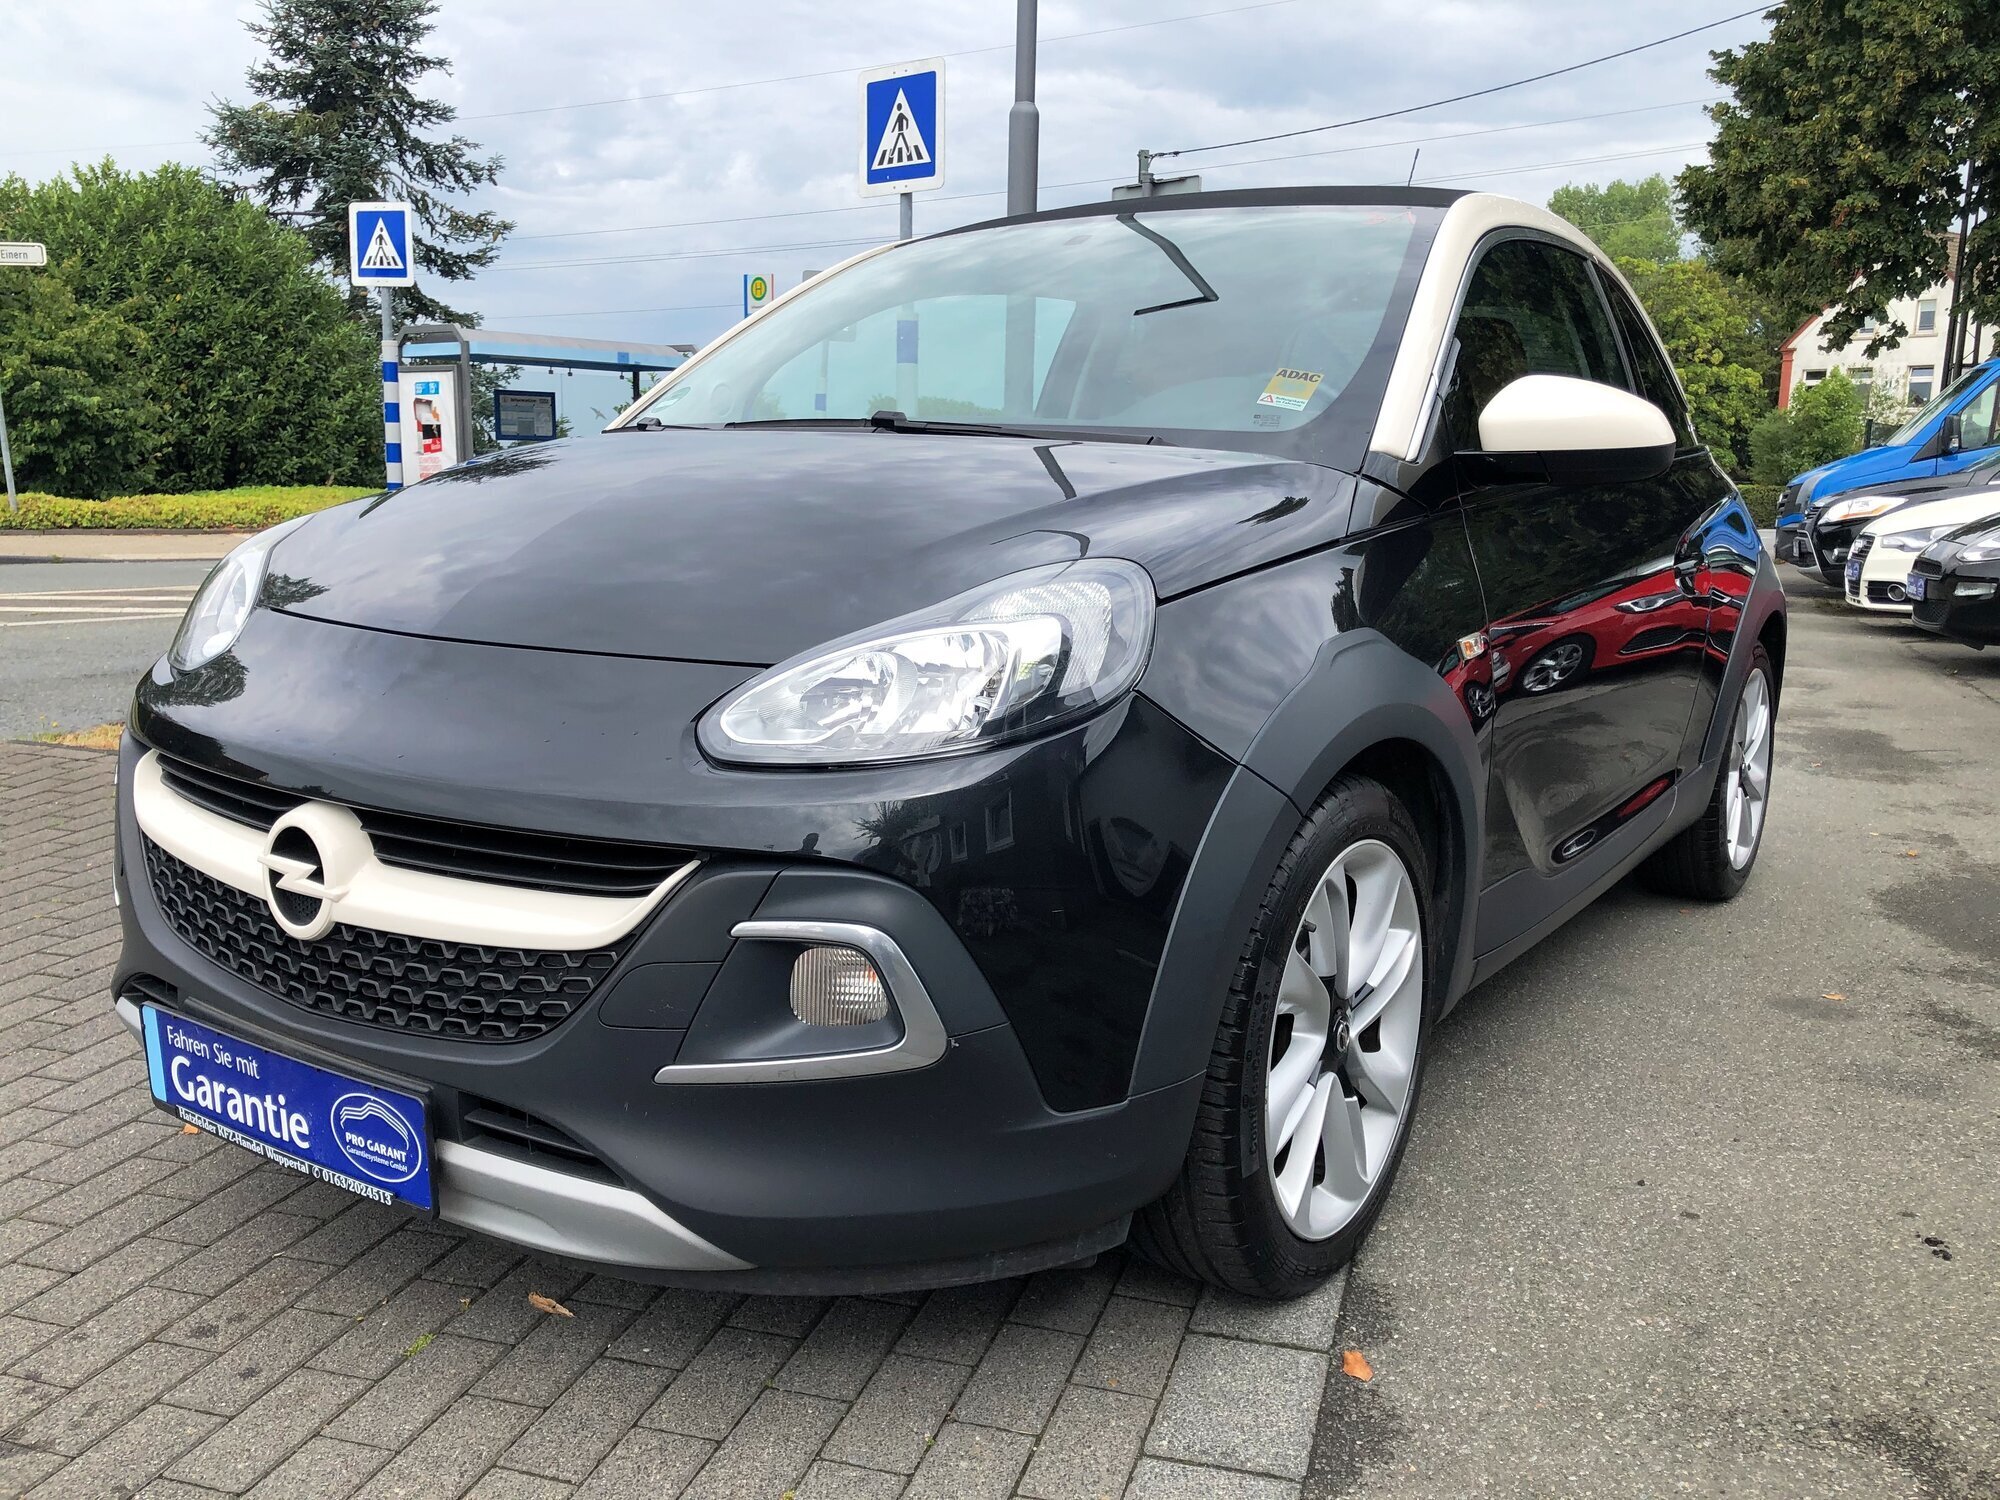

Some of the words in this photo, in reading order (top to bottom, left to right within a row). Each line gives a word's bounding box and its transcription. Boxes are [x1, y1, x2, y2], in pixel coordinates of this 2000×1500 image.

[1, 249, 28, 259] Einern
[1276, 369, 1321, 383] ADAC
[166, 1025, 210, 1060] Fahren
[212, 1043, 232, 1069] Sie
[236, 1055, 260, 1080] mit
[170, 1055, 310, 1149] Garantie
[345, 1131, 365, 1148] PRO
[366, 1140, 407, 1163] GARANT
[346, 1144, 389, 1167] Garantiesysteme
[389, 1160, 408, 1173] GmbH
[217, 1125, 264, 1156] KFZ-Handel
[265, 1145, 310, 1175] Wuppertal
[322, 1170, 393, 1206] 0163/2024513
